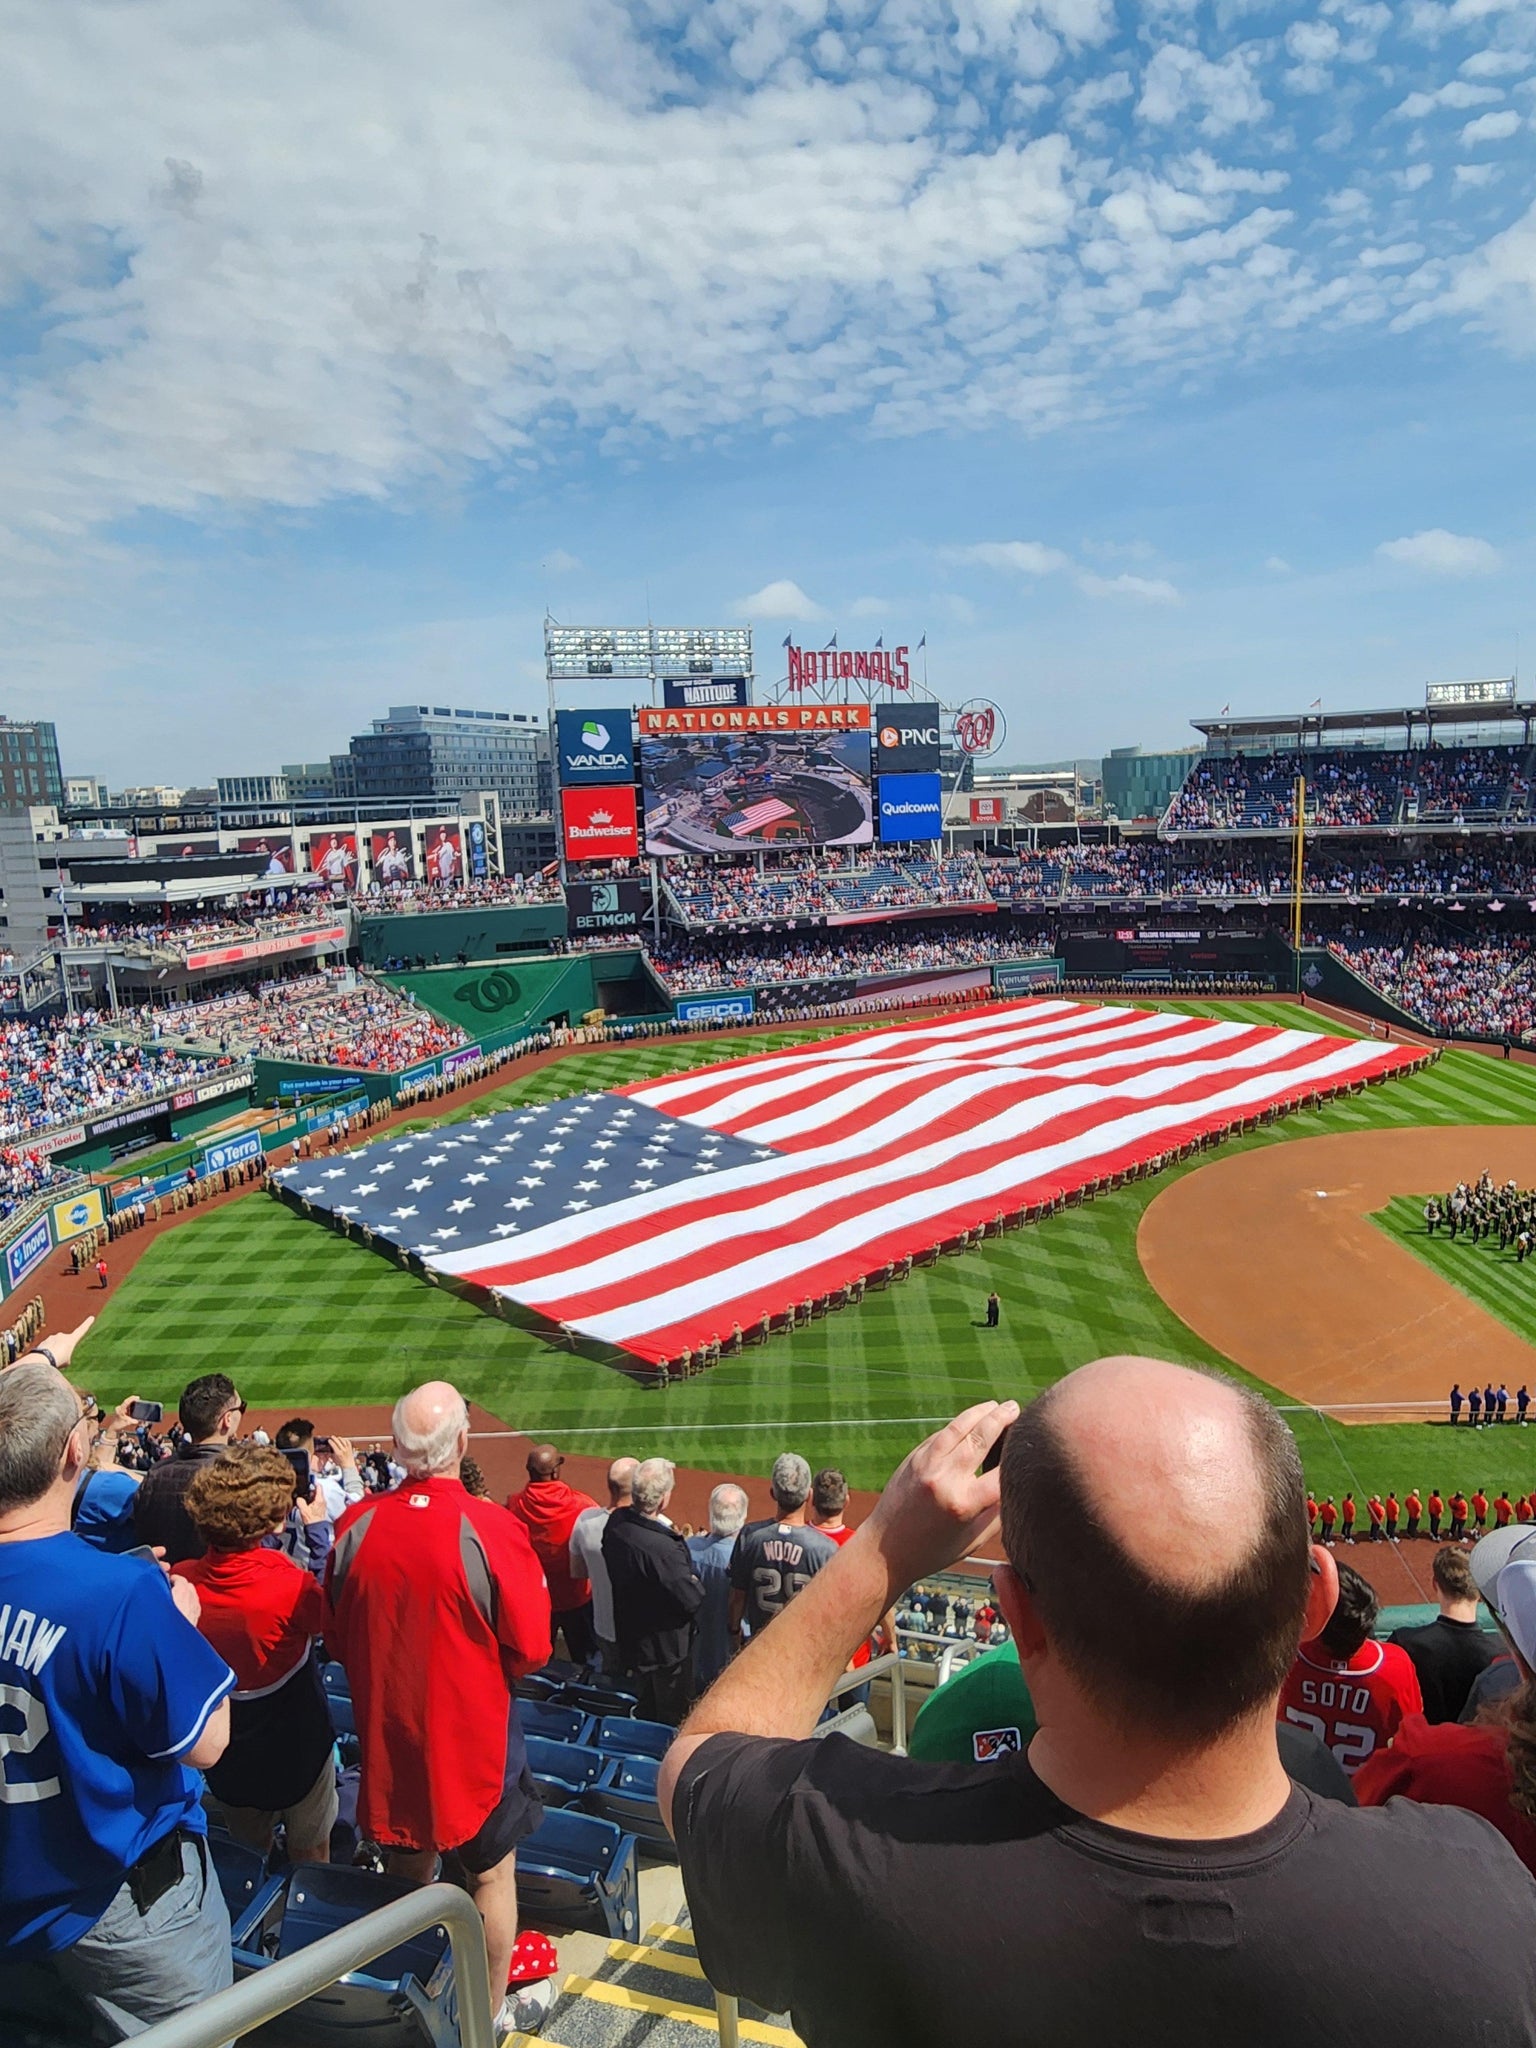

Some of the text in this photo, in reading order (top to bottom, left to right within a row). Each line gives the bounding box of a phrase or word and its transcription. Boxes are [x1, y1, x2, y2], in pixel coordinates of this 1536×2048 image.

[788, 645, 909, 691] NATIONALS
[683, 684, 737, 703] NATITUDE
[648, 709, 860, 729] NATIONALS PARK
[900, 728, 939, 745] PNC
[566, 754, 628, 766] VANDA
[882, 801, 939, 816] Qualcomm
[569, 825, 633, 838] Budweiser
[576, 912, 636, 928] BETMGM
[1116, 931, 1134, 939] 12:55
[1000, 975, 1030, 985] VENTURE
[686, 1002, 744, 1019] GEICO
[226, 1074, 251, 1092] FAN
[175, 1092, 193, 1109] 12:55
[92, 1101, 169, 1135] WELCOME TO NATIONALS PARK
[23, 1141, 53, 1157] Harris
[224, 1139, 258, 1160] Terra
[22, 1227, 47, 1260] Inova
[763, 1540, 803, 1565] WOOD
[1302, 1680, 1370, 1714] SOTO
